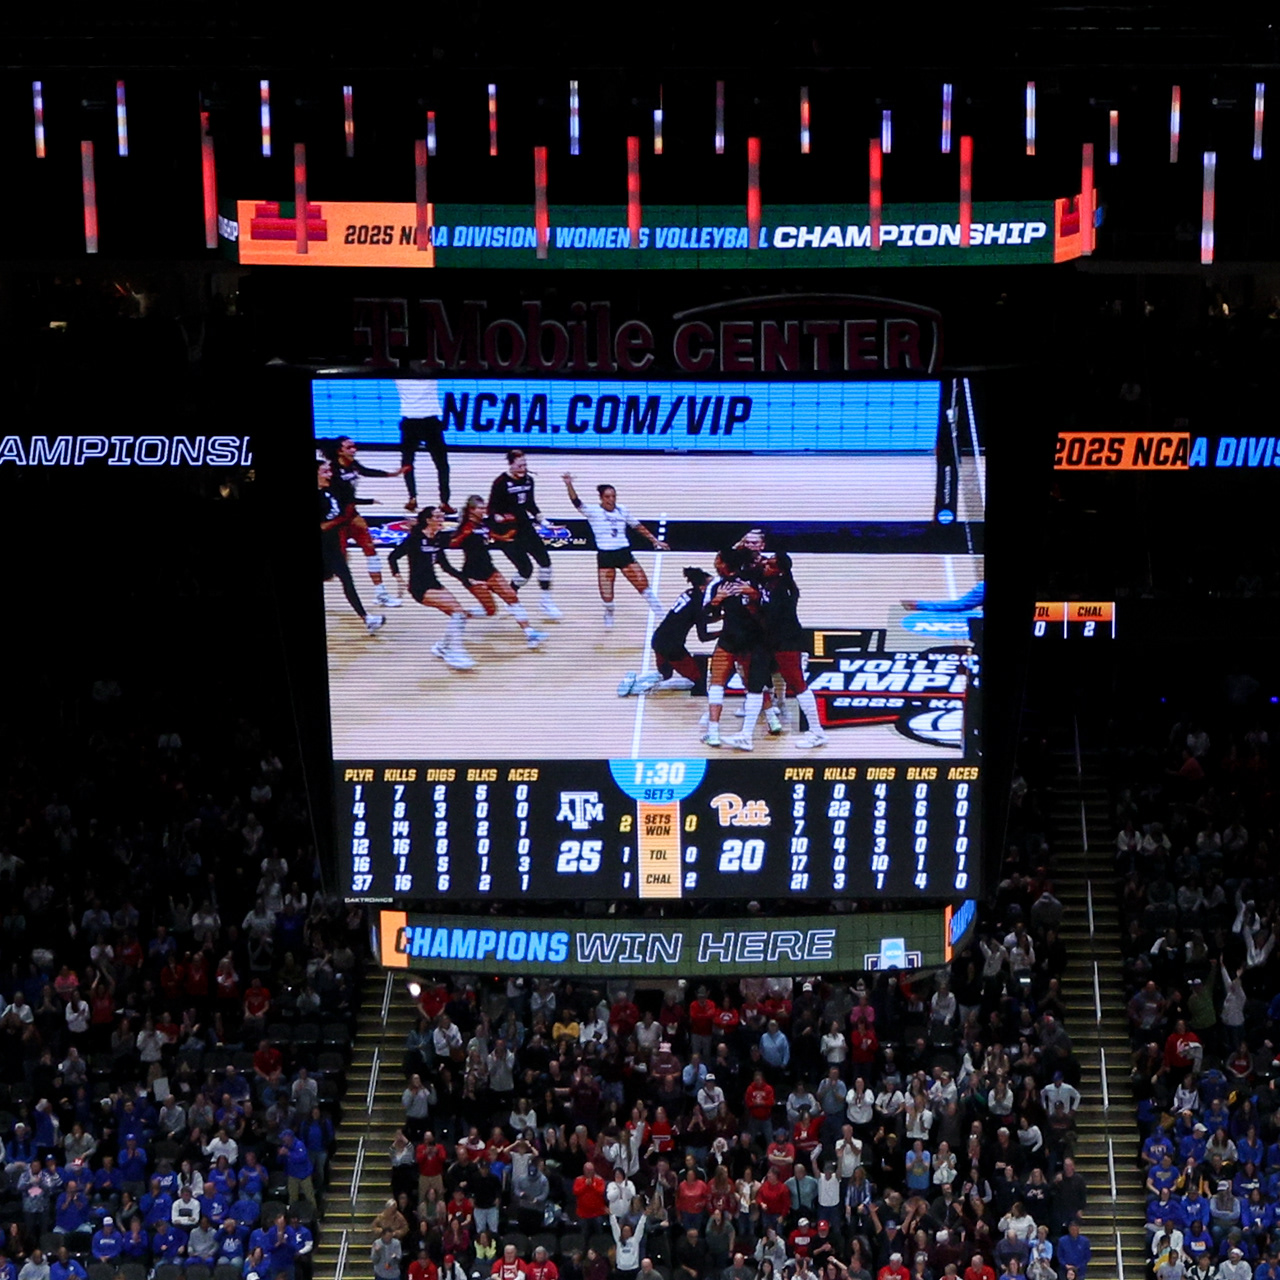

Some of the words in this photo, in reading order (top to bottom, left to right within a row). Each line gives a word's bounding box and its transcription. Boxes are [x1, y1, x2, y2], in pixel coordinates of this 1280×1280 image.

[344, 225, 394, 246] 2025
[453, 226, 536, 248] DIVISION
[654, 226, 769, 249] VOLLEYBAL
[773, 222, 1047, 249] CHAMPIONSHIP
[673, 318, 921, 372] CENTER
[441, 391, 753, 436] NCAA.COM/VIP
[1055, 436, 1123, 467] 2025
[1131, 436, 1208, 467] NCAA
[1077, 606, 1103, 618] CHAL
[1033, 620, 1047, 638] 0
[1083, 620, 1096, 638] 2
[345, 769, 374, 781] PLYR
[384, 769, 416, 781] KILLS
[427, 769, 455, 781] DIGS
[467, 769, 497, 781] BLKS
[508, 769, 538, 781] ACES
[634, 762, 685, 785] 1:30
[785, 768, 813, 780] PLYR
[824, 768, 856, 780] KILLS
[867, 768, 895, 780] DIGS
[907, 768, 937, 780] BLKS
[948, 767, 978, 779] ACES
[355, 785, 361, 800] 1
[395, 785, 404, 800] 7
[434, 785, 445, 800] 2
[476, 785, 487, 800] 5
[516, 785, 528, 800] 0
[644, 789, 664, 800] SET
[666, 789, 674, 800] 3
[793, 784, 804, 799] 3
[834, 784, 845, 799] 0
[875, 784, 886, 799] 4
[915, 784, 927, 799] 0
[957, 784, 968, 799] 0
[353, 802, 365, 818] 4
[394, 802, 405, 818] 8
[435, 802, 446, 818] 3
[477, 802, 488, 818] 0
[517, 802, 528, 818] 0
[710, 793, 771, 827] Pitt
[793, 801, 805, 817] 5
[828, 801, 850, 817] 22
[874, 801, 886, 816] 3
[915, 801, 927, 816] 6
[956, 801, 968, 816] 0
[620, 815, 632, 832] 2
[645, 814, 671, 824] SETS
[685, 815, 697, 832] 0
[795, 820, 804, 835] 7
[834, 820, 845, 835] 0
[874, 820, 886, 835] 5
[915, 820, 927, 835] 0
[959, 819, 965, 834] 1
[354, 821, 365, 836] 9
[393, 821, 409, 836] 14
[436, 821, 447, 836] 2
[477, 821, 488, 836] 2
[520, 821, 526, 836] 1
[646, 825, 671, 836] WON
[353, 839, 369, 854] 12
[393, 839, 410, 854] 16
[437, 839, 448, 854] 8
[478, 839, 489, 854] 0
[518, 839, 529, 854] 0
[791, 837, 808, 852] 10
[834, 837, 845, 852] 4
[874, 837, 886, 852] 3
[915, 837, 927, 852] 0
[956, 837, 967, 852] 0
[557, 841, 602, 872] 25
[623, 847, 630, 863] 1
[650, 850, 667, 860] TOL
[686, 847, 697, 862] 0
[719, 839, 765, 871] 20
[792, 855, 807, 871] 17
[834, 855, 845, 870] 0
[872, 855, 889, 870] 10
[918, 855, 924, 870] 1
[958, 855, 965, 870] 1
[354, 857, 370, 872] 16
[400, 856, 406, 872] 1
[437, 856, 448, 872] 5
[481, 857, 488, 872] 1
[519, 856, 530, 871] 3
[353, 875, 372, 890] 37
[395, 875, 411, 890] 16
[438, 875, 449, 890] 6
[479, 875, 490, 890] 2
[522, 875, 528, 890] 1
[624, 872, 630, 888] 1
[646, 874, 672, 884] CHAL
[685, 872, 697, 887] 2
[791, 873, 808, 889] 21
[834, 873, 845, 889] 3
[877, 873, 884, 889] 1
[915, 873, 926, 889] 4
[956, 873, 967, 888] 0
[395, 927, 570, 962] CHAMPIONS
[576, 932, 683, 963] WIN
[697, 928, 837, 964] HERE
